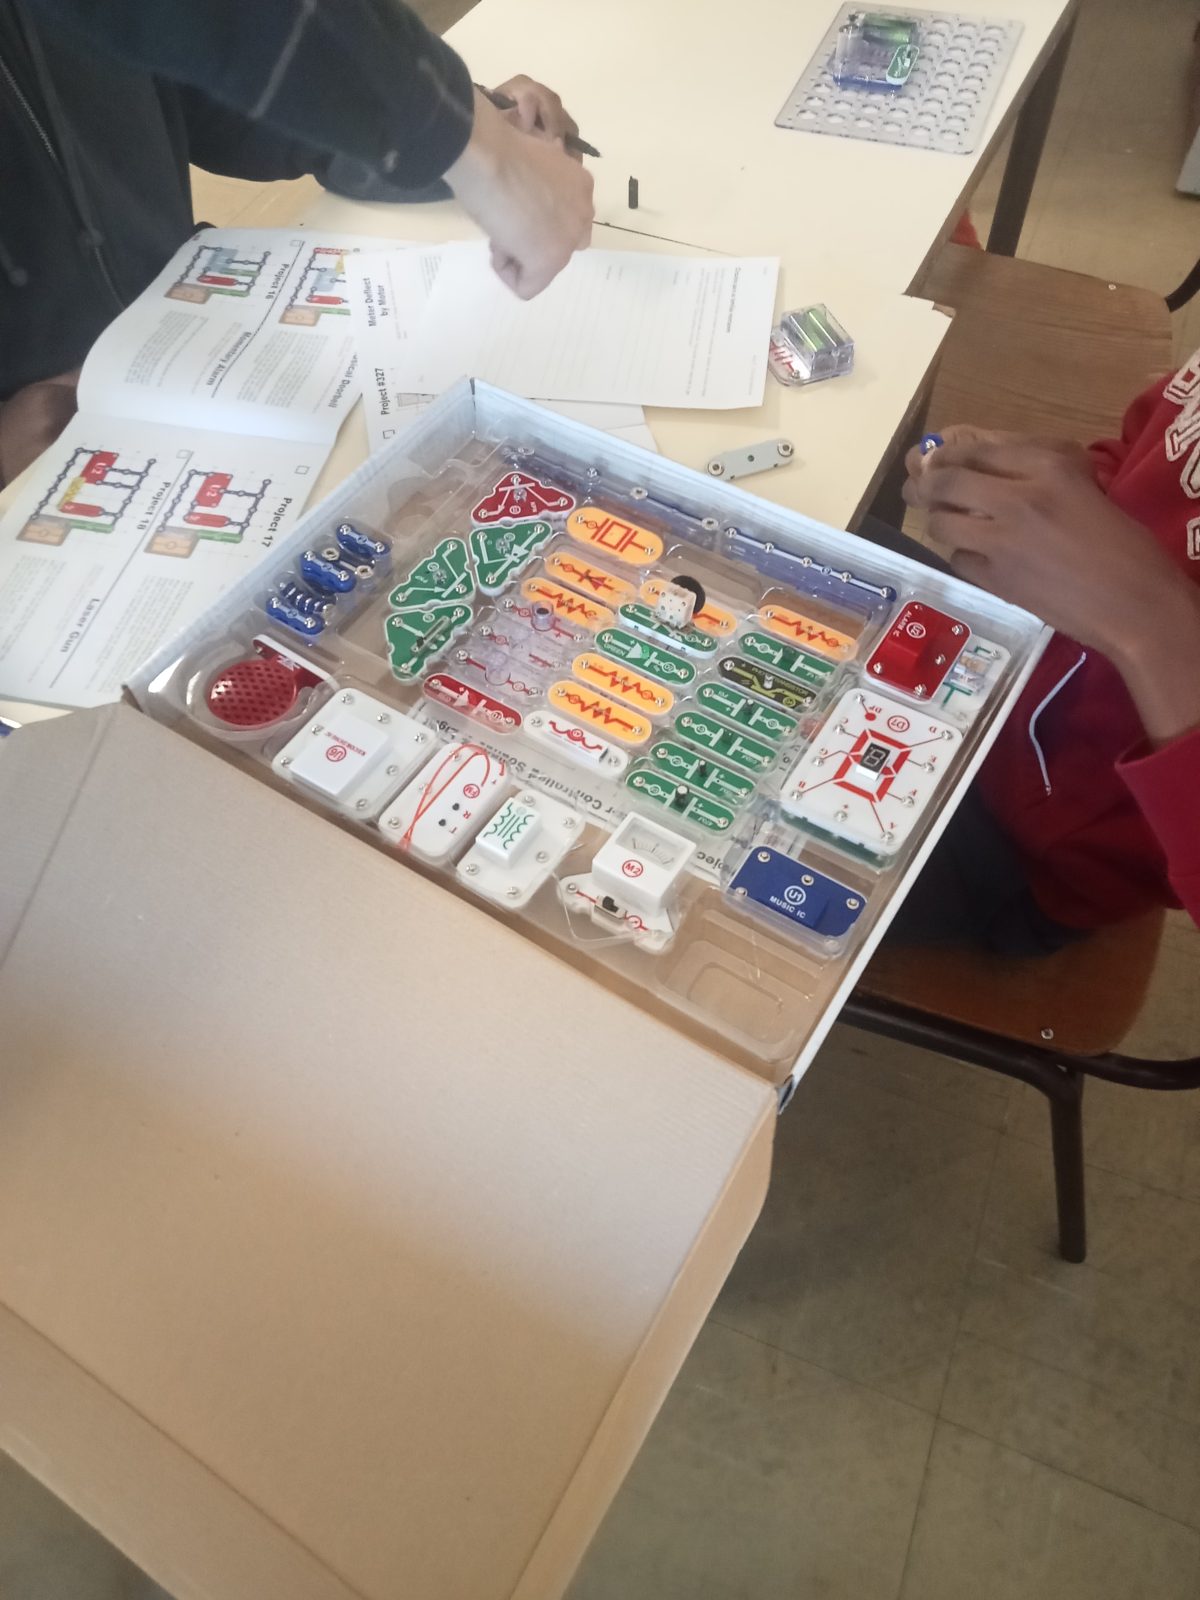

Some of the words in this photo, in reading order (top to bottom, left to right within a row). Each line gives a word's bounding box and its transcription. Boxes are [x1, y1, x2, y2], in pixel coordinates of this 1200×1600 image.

[271, 263, 290, 292] Project
[363, 277, 374, 303] Deflect
[378, 285, 386, 306] Motor
[368, 306, 376, 327] Meter
[380, 306, 388, 316] by
[221, 331, 252, 364] Momentary
[206, 362, 226, 386] Alarm
[374, 368, 386, 386] #327
[328, 379, 350, 408] Doorbell
[377, 388, 390, 416] Project
[148, 481, 172, 518] Project
[272, 497, 292, 536] Project
[76, 598, 100, 629] Laser
[898, 610, 912, 630] ALARM
[60, 629, 77, 654] Gun
[768, 894, 796, 914] MUSIC
